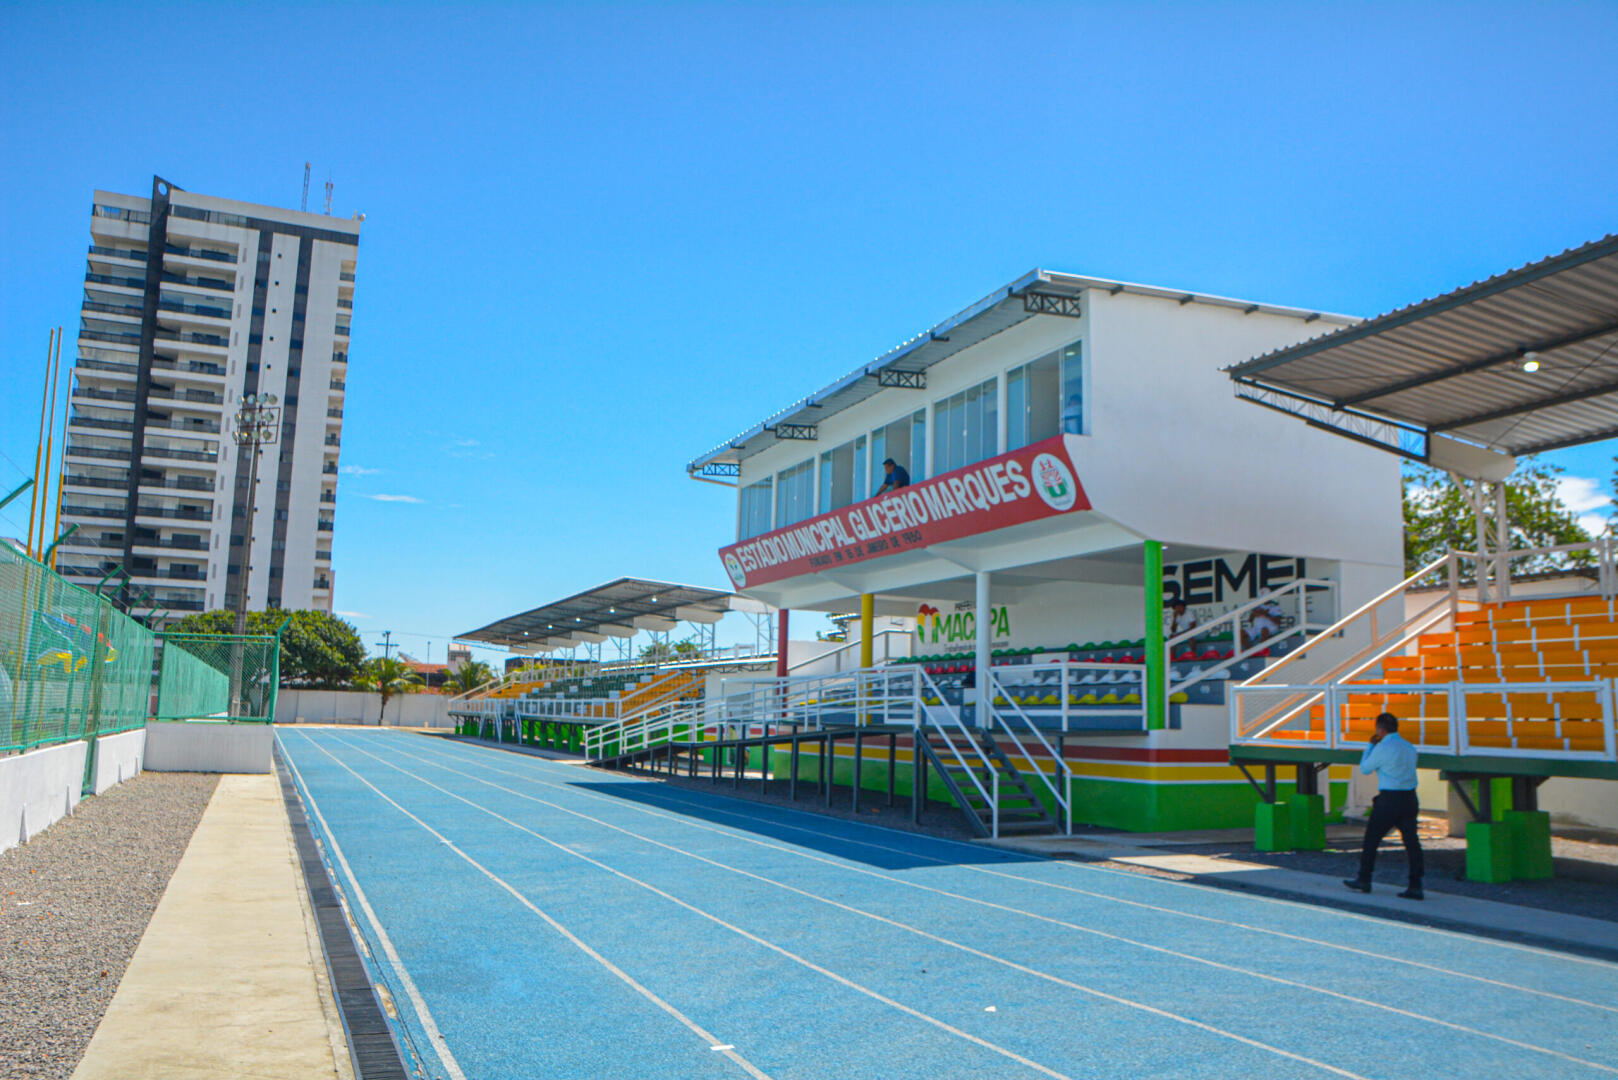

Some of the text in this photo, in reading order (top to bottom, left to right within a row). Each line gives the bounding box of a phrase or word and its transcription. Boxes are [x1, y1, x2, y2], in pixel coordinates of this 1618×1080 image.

[735, 459, 1031, 572] ESTÁDIO MUNICIPAL GLICÉRIO MARQUES
